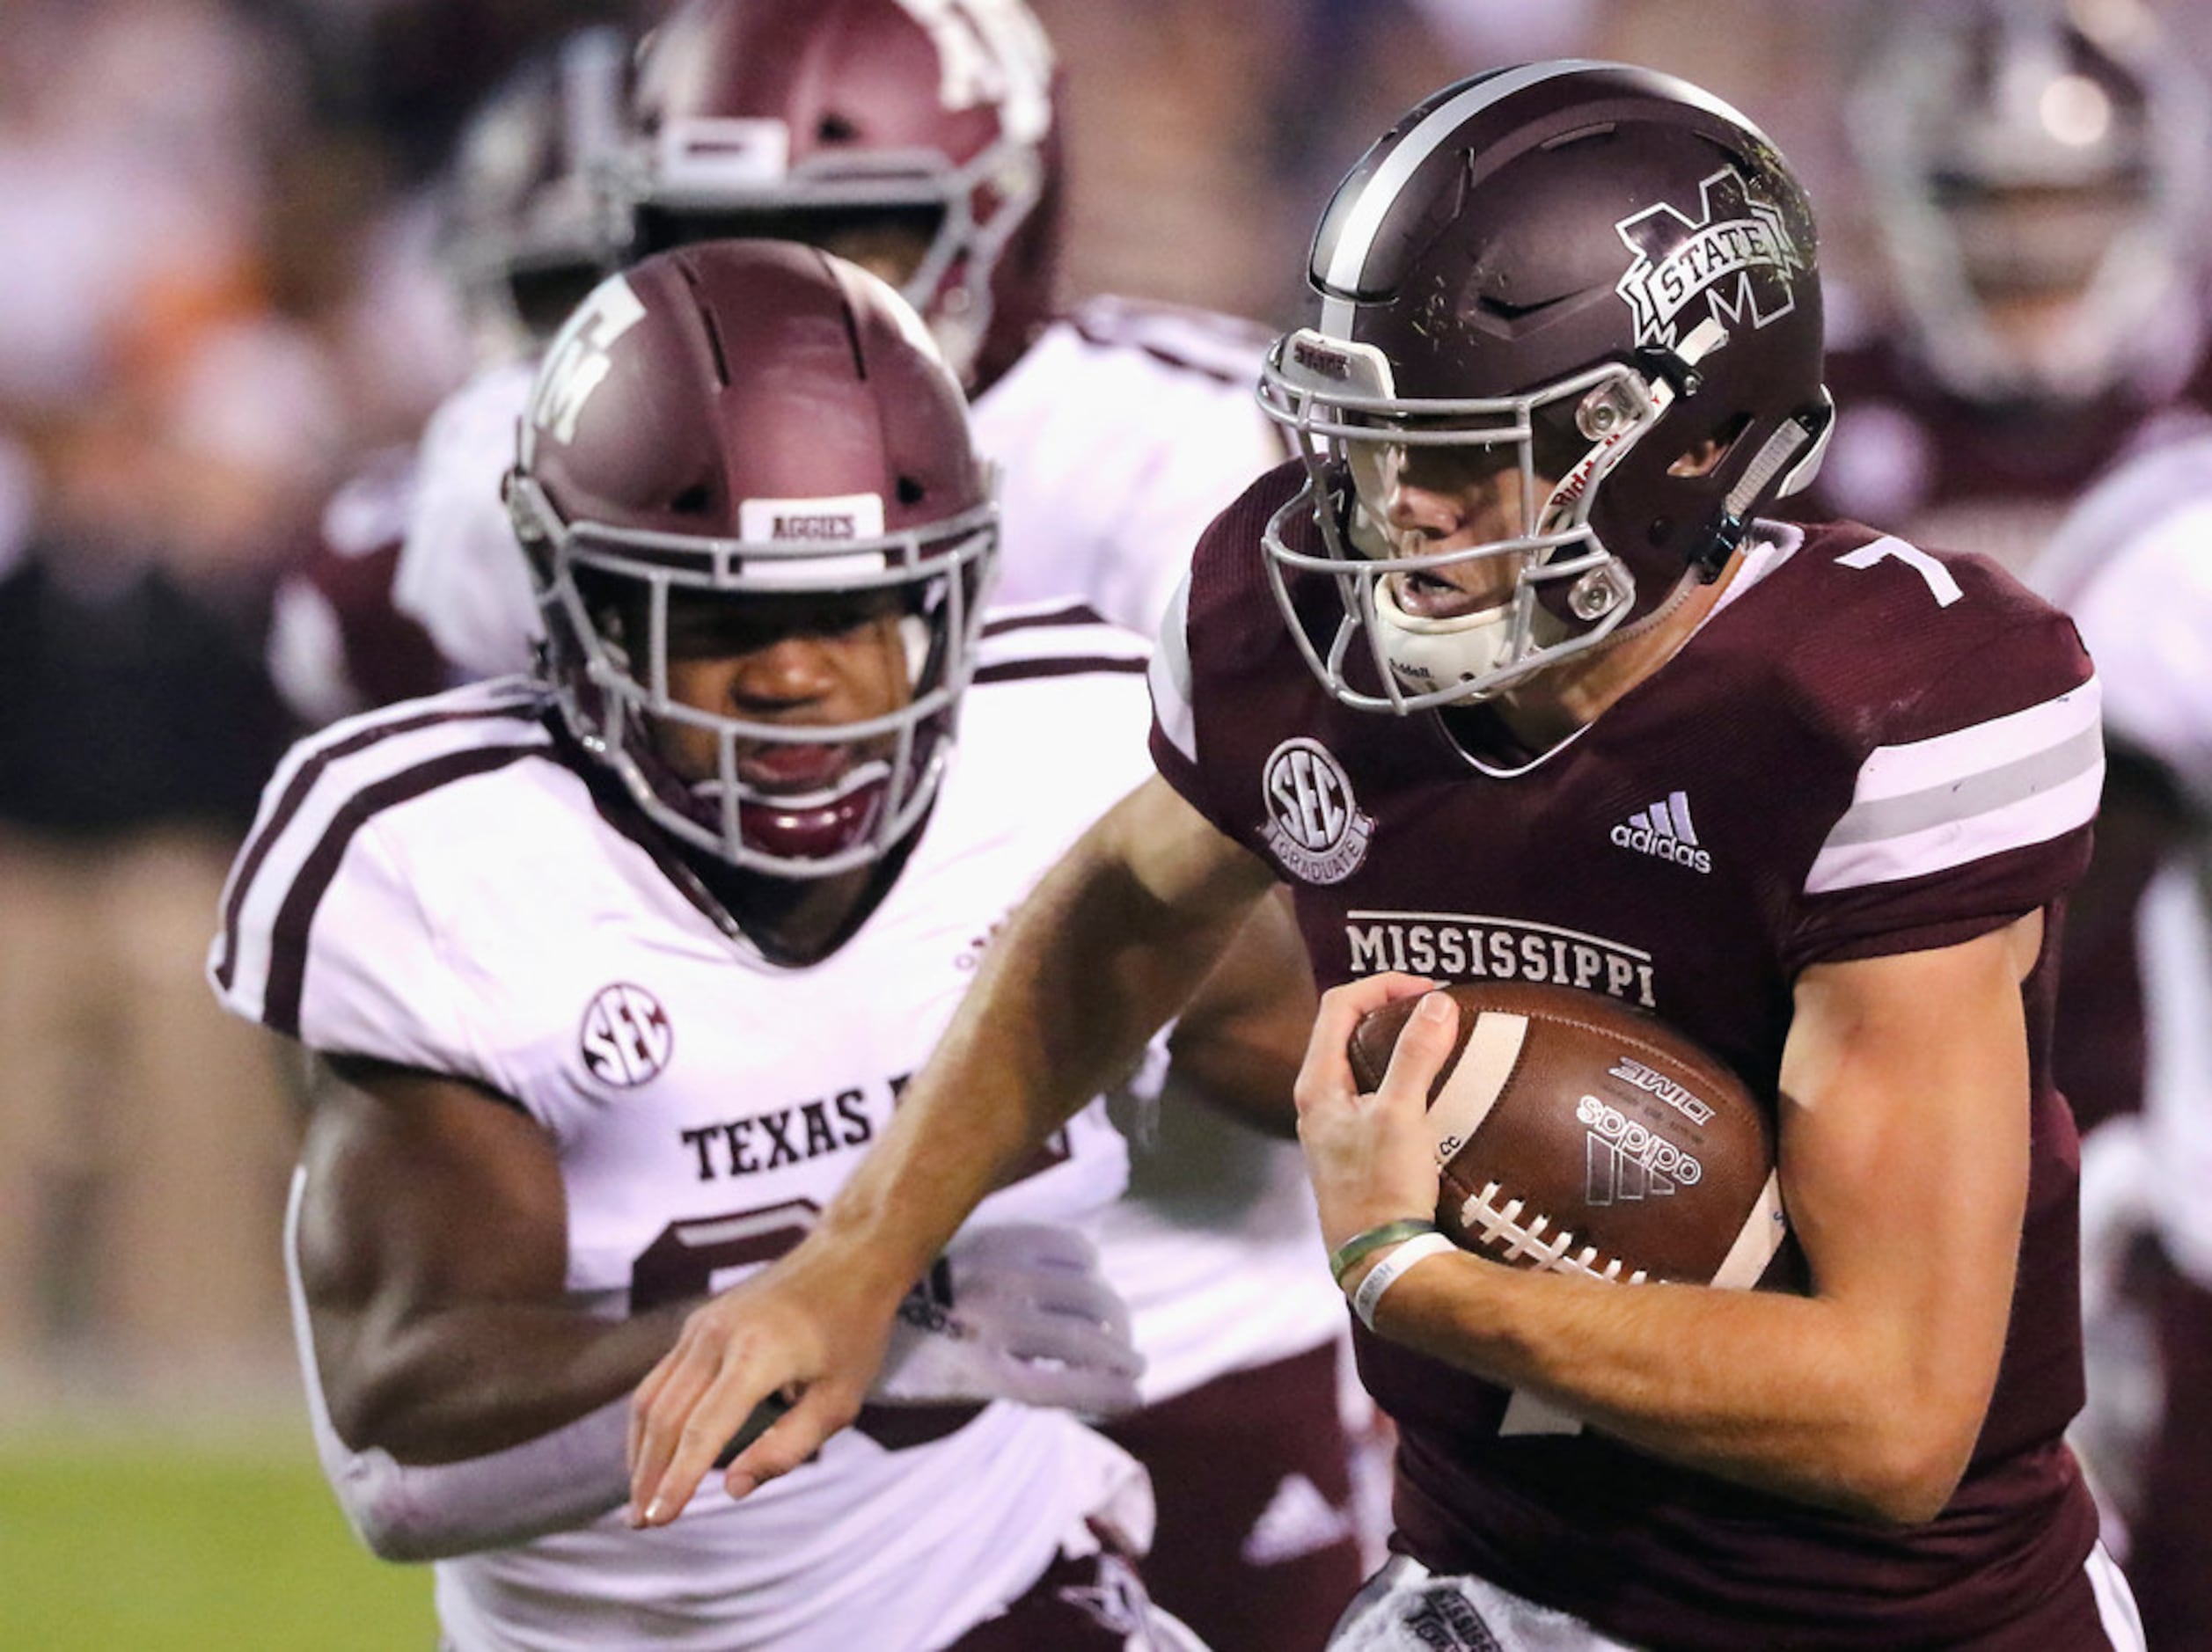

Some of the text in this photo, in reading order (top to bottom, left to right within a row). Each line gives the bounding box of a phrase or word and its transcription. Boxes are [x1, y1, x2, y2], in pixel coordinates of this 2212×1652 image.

[1659, 225, 1767, 304] STATE
[772, 515, 855, 540] AGGIES
[1833, 535, 1965, 609] 7
[1271, 749, 1346, 849] SEC
[1279, 839, 1360, 880] GRADUATE
[1610, 822, 1712, 874] adidas
[1345, 925, 1657, 1008] MISSISSIPPI
[582, 984, 670, 1086] SEC
[1608, 1056, 1716, 1127] DIME
[681, 1086, 873, 1181] TEXAS
[1576, 1094, 1703, 1186] adidas
